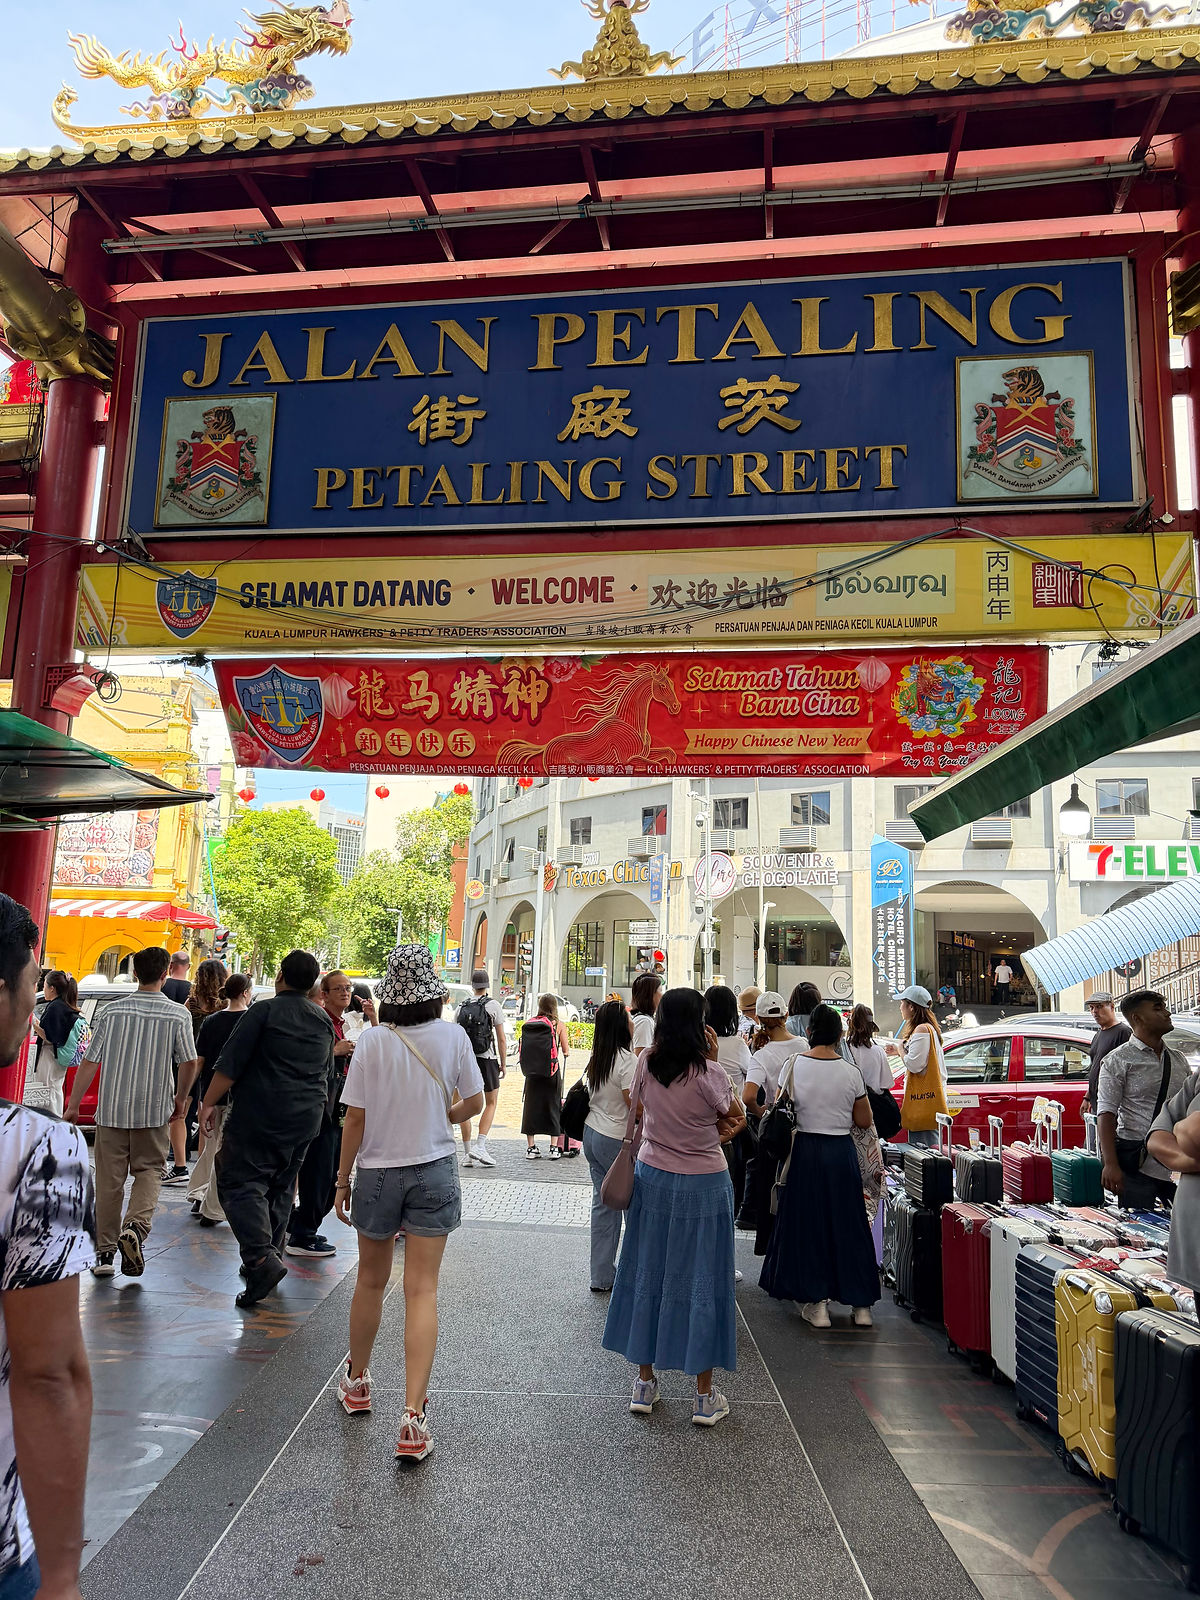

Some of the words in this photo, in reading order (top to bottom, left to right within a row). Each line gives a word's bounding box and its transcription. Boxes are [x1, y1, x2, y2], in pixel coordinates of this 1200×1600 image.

[182, 316, 499, 389] JALAN
[527, 280, 1073, 371] PETALING
[312, 456, 624, 510] PETALING
[645, 443, 908, 500] STREET
[1037, 473, 1058, 486] Kuala
[1057, 455, 1083, 475] Lumpur
[240, 580, 349, 609] SELAMAT
[353, 578, 452, 607] DATANG
[491, 575, 615, 605] WELCOME
[651, 575, 789, 610] 欢迎光临
[824, 570, 947, 602] நல்வரவு
[986, 550, 1012, 621] 丙申年
[244, 629, 281, 639] KUALA
[283, 629, 328, 638] LUMPUR
[330, 628, 388, 638] HAWKERS'
[389, 628, 397, 637] &
[400, 627, 434, 637] PETTY
[437, 627, 491, 637] TRADERS'
[492, 626, 567, 636] ASSOCIATION
[715, 621, 760, 633] PERSATUAN
[761, 620, 795, 632] PENJAJA
[797, 619, 813, 631] DAN
[815, 619, 850, 631] PENIAGA
[851, 618, 874, 629] KECIL
[875, 617, 903, 629] KUALA
[904, 617, 938, 628] LUMPUR
[684, 665, 783, 691] Selamat
[786, 664, 861, 691] Tahun
[348, 668, 551, 723] 龍马精神
[739, 691, 800, 716] Baru
[802, 690, 861, 716] Cina
[983, 706, 1028, 722] LOONG
[358, 731, 472, 753] 新年快乐
[694, 733, 738, 750] Happy
[741, 733, 793, 747] Chinese
[797, 734, 828, 747] New
[832, 733, 863, 747] Year
[350, 762, 398, 773] PERSATUAN
[399, 763, 436, 775] PENJAJA
[437, 764, 456, 774] DAN
[457, 764, 496, 774] PENIAGA
[497, 765, 522, 775] KECIL
[523, 765, 539, 775] K.L.
[647, 765, 663, 775] K.L.
[665, 764, 713, 774] HAWKERS'
[715, 765, 723, 774] &
[724, 765, 753, 774] PETTY
[754, 764, 800, 775] TRADERS'
[804, 764, 870, 775] ASSOCIATION
[902, 755, 921, 769] Try
[938, 754, 970, 768] You'll
[565, 867, 608, 888] Texas
[612, 859, 683, 884] Chicn
[743, 853, 822, 869] SOUVENIR
[824, 856, 835, 867] &
[742, 870, 837, 885] CHOCOLATE
[887, 907, 895, 936] HOTEL
[897, 907, 905, 945] PACIFIC
[887, 940, 896, 993] CHINATOWN
[896, 948, 906, 991] EXPRESS
